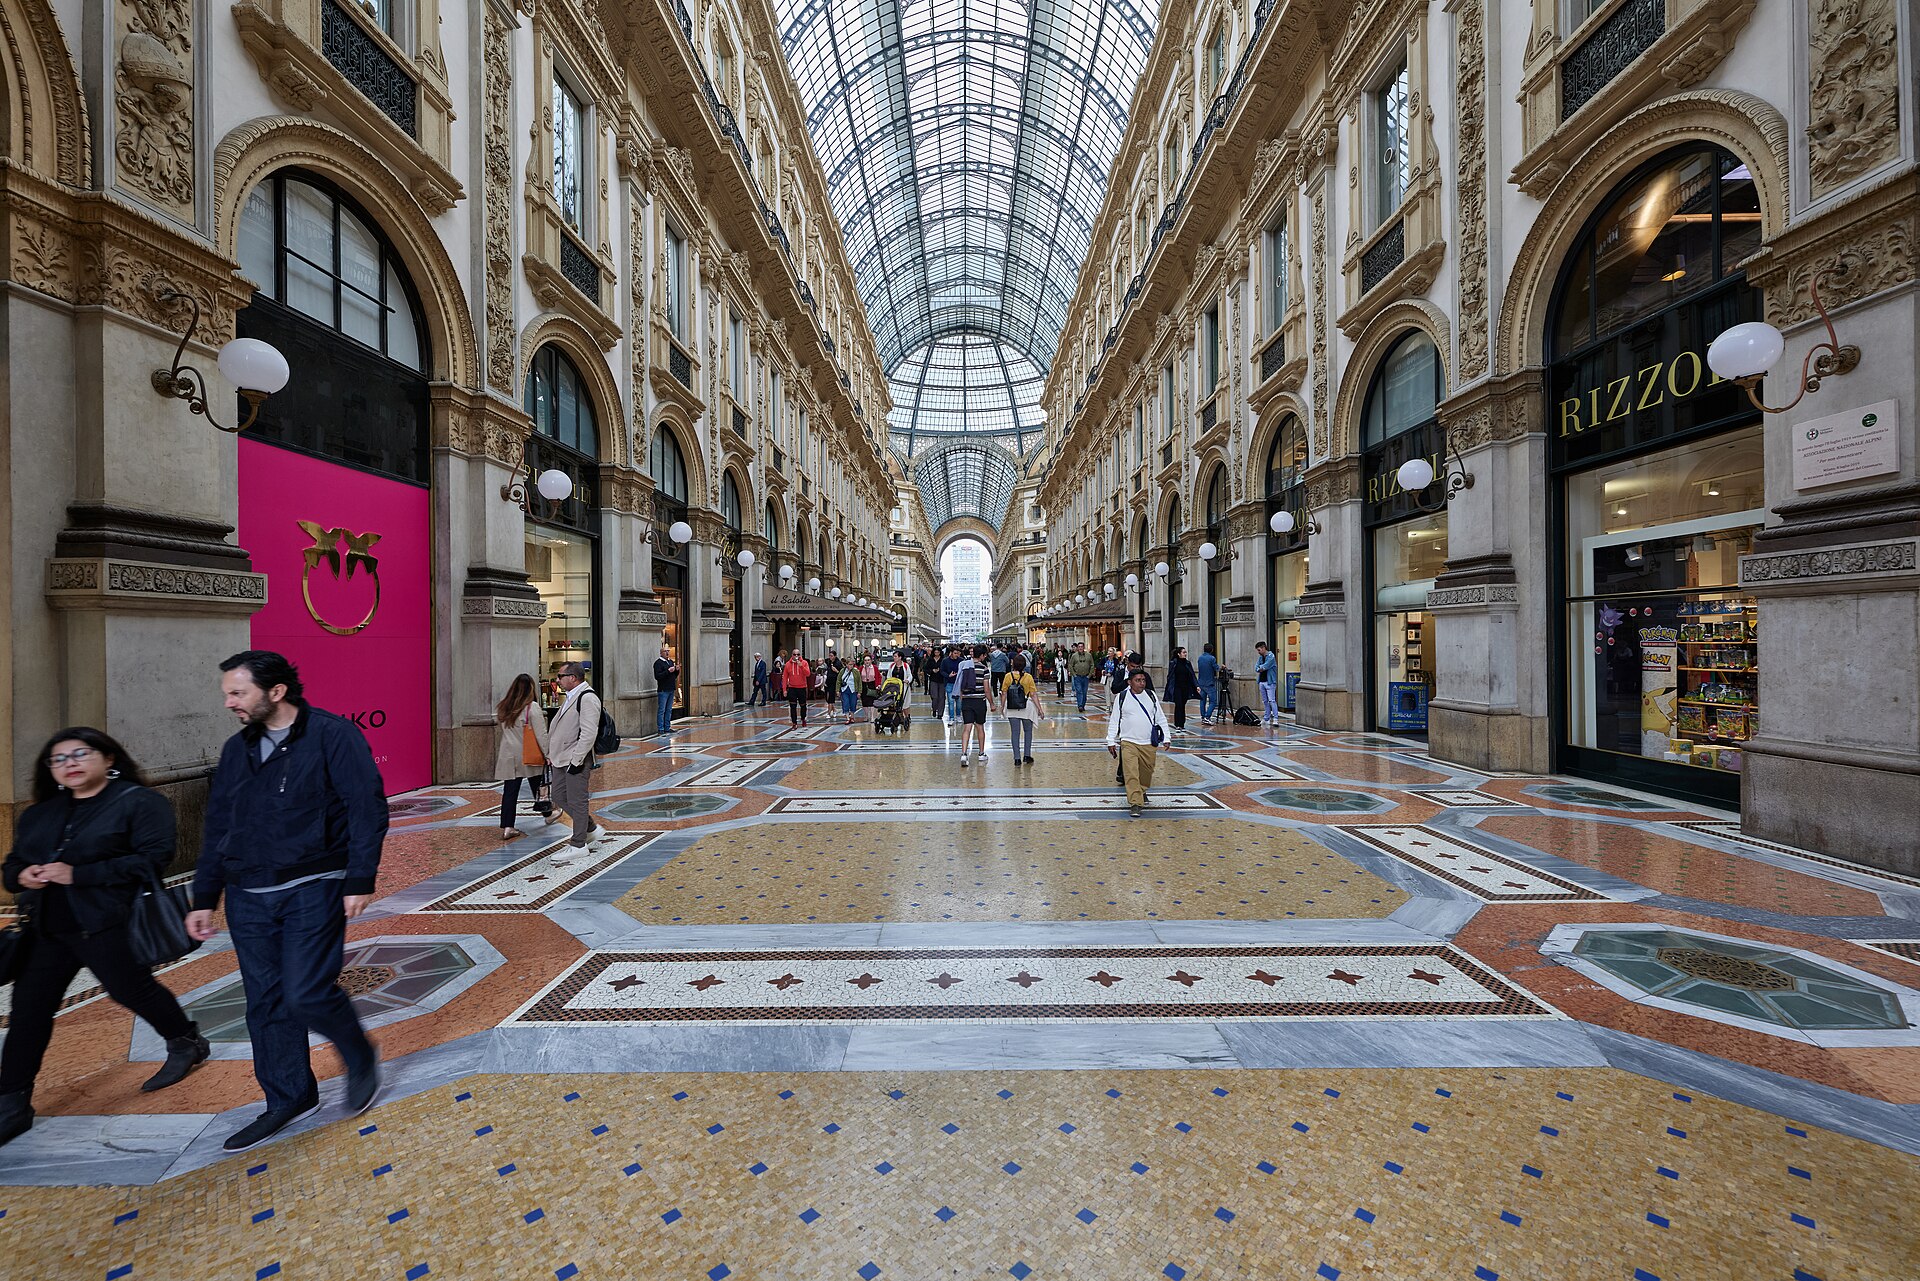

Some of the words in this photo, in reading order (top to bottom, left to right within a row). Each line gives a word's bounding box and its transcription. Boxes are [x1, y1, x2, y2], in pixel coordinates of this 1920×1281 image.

[1836, 440, 1864, 451] NAZIONALE
[1864, 436, 1882, 444] ALPINI
[780, 594, 811, 604] Salotto
